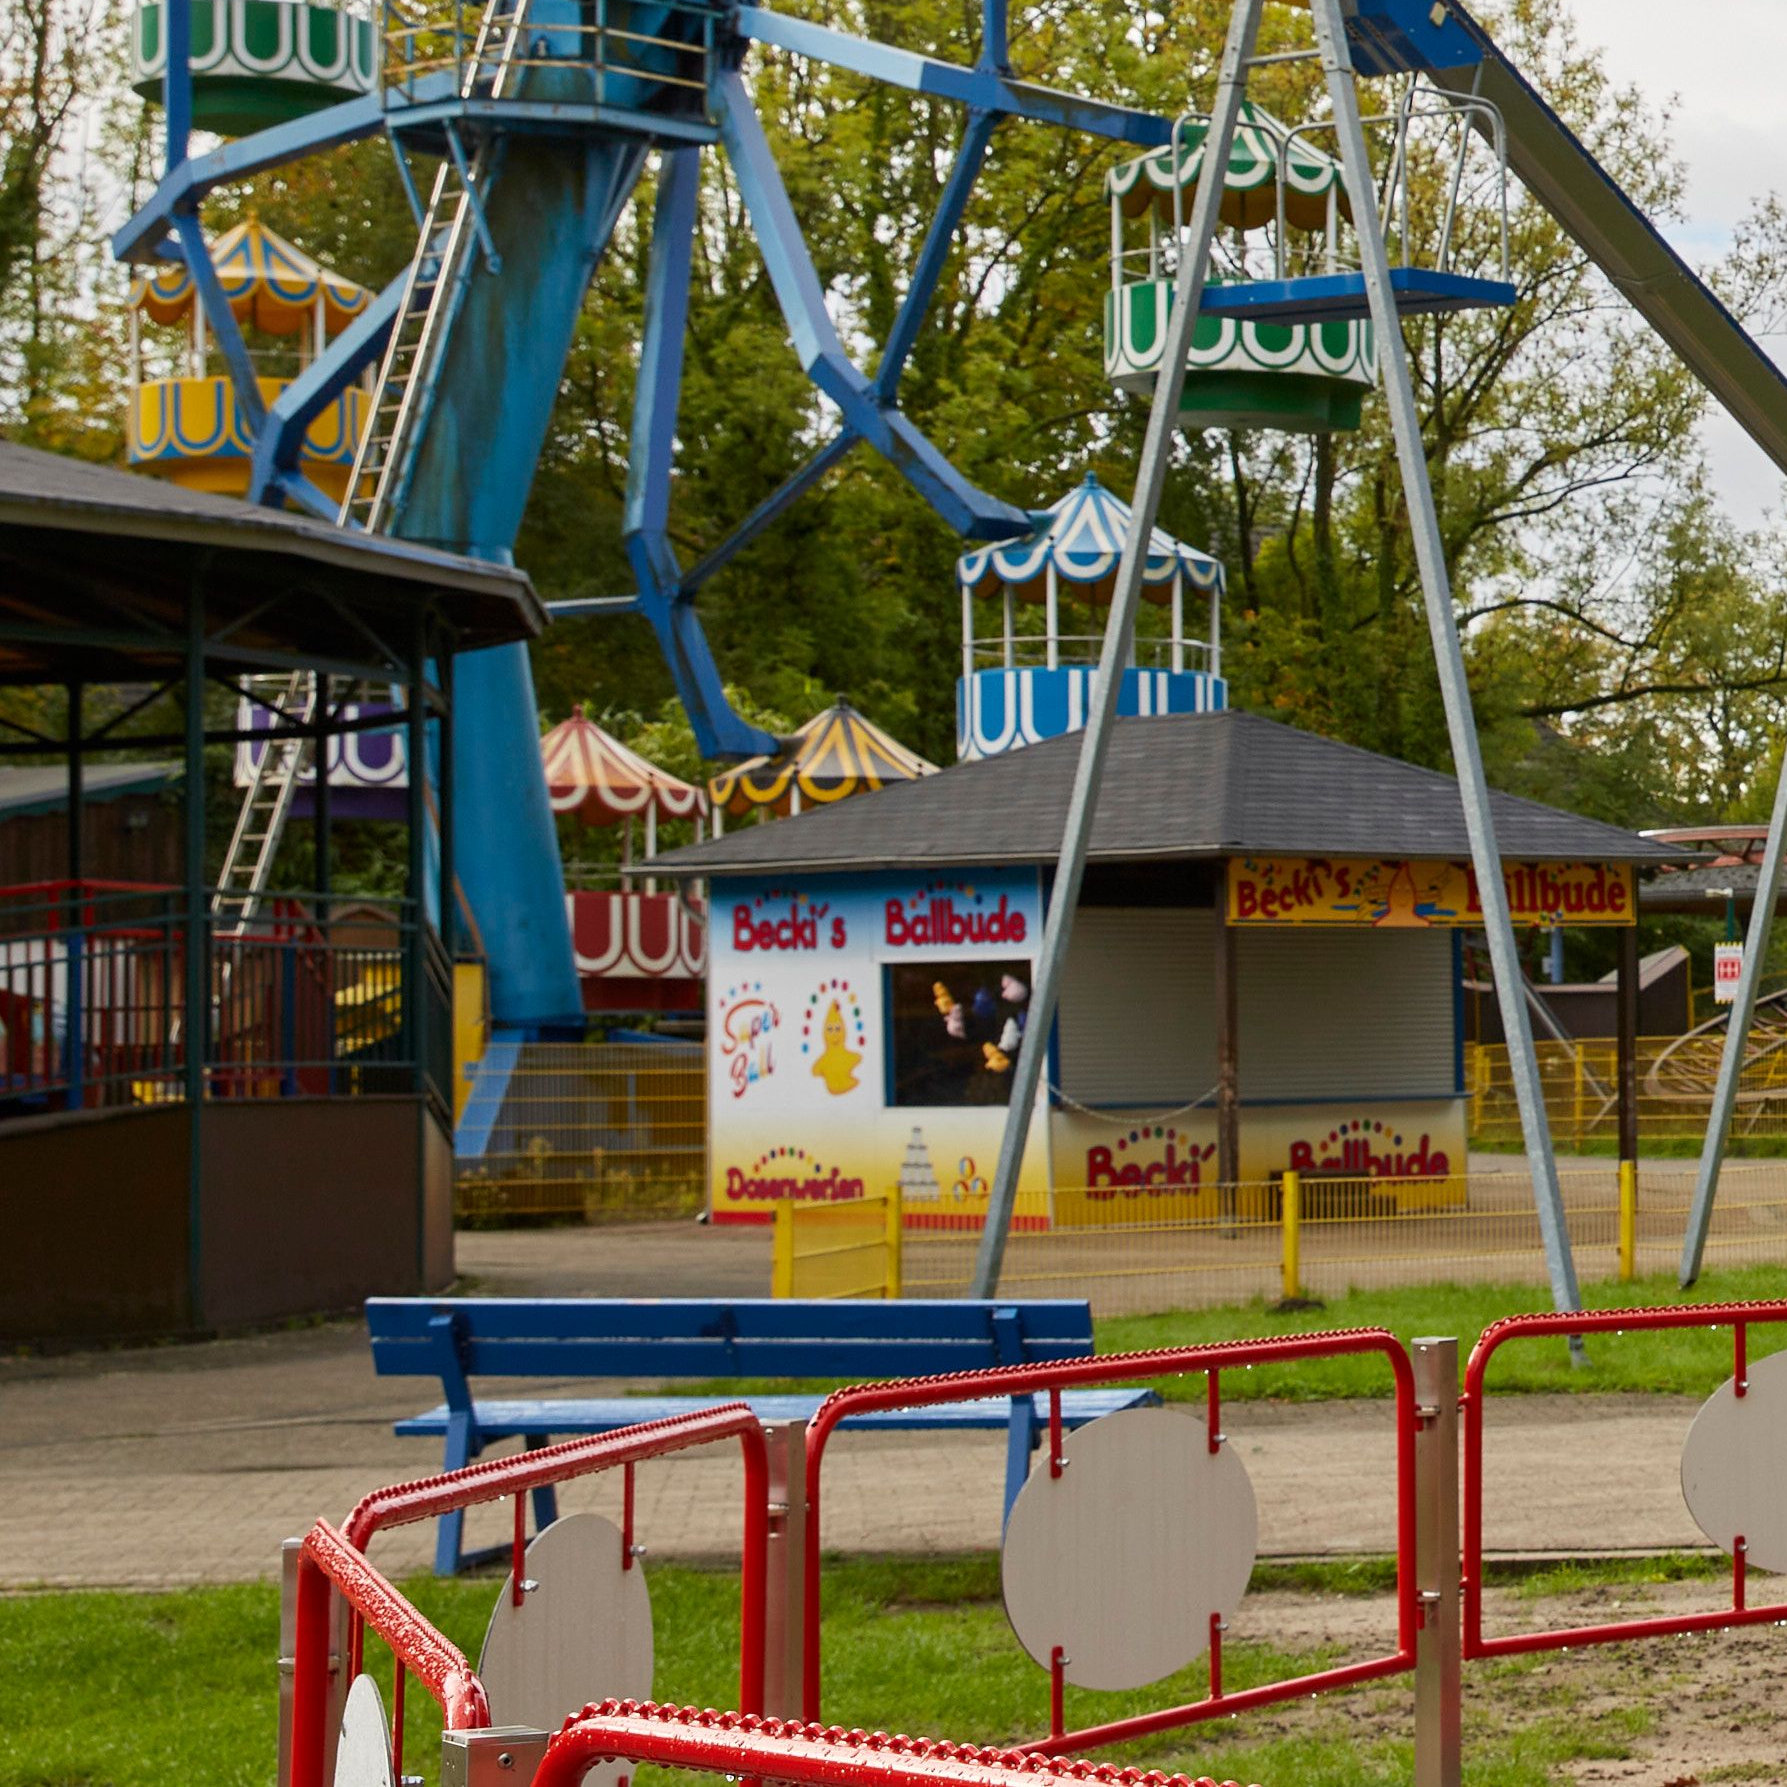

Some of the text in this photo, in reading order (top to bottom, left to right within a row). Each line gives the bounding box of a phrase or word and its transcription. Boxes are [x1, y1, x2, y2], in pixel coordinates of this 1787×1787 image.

[1467, 868, 1626, 913] llbude
[733, 894, 1027, 952] Becki's Ballbude
[730, 1041, 774, 1099] Ball
[1086, 1142, 1217, 1201] Becki'
